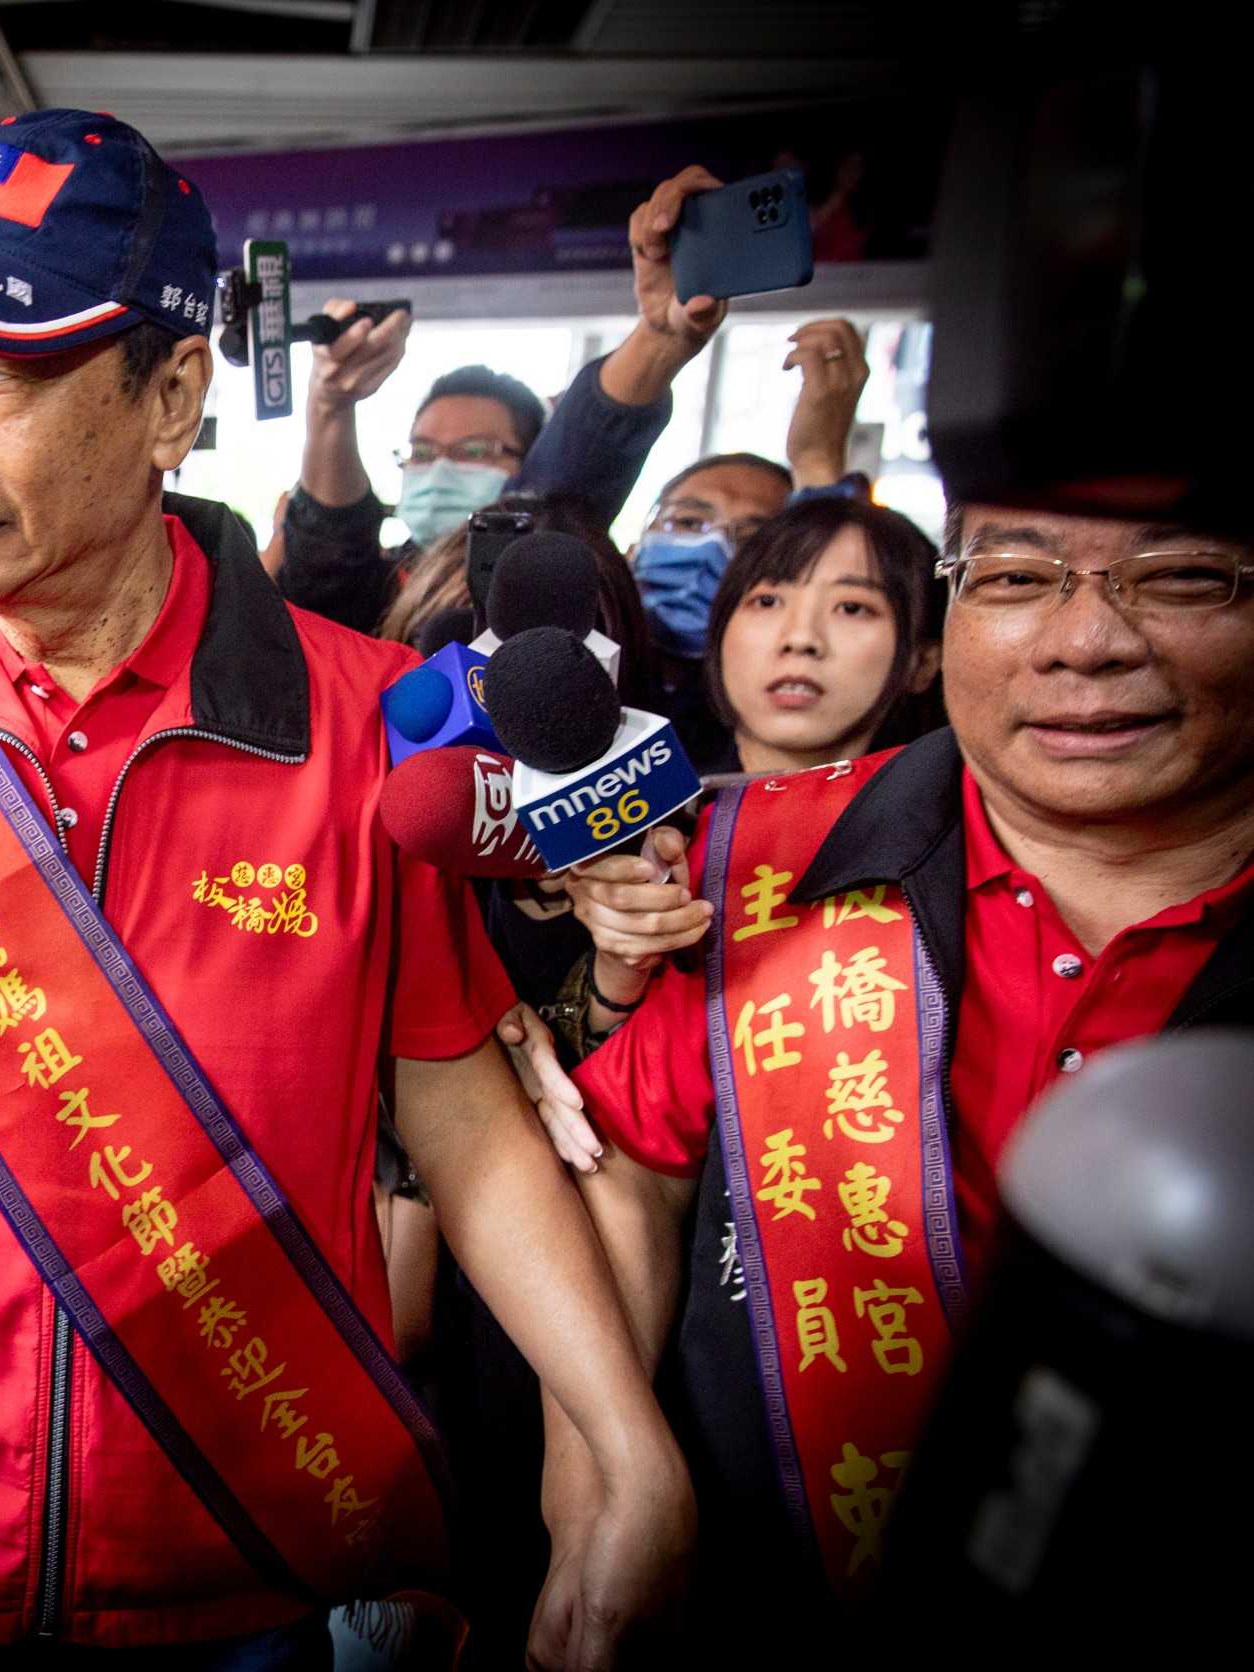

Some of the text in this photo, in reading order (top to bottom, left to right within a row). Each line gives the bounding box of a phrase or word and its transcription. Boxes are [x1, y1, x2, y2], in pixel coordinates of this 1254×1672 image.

[528, 739, 672, 831] mnews
[586, 788, 650, 841] 86
[732, 864, 847, 1374] 主任委員
